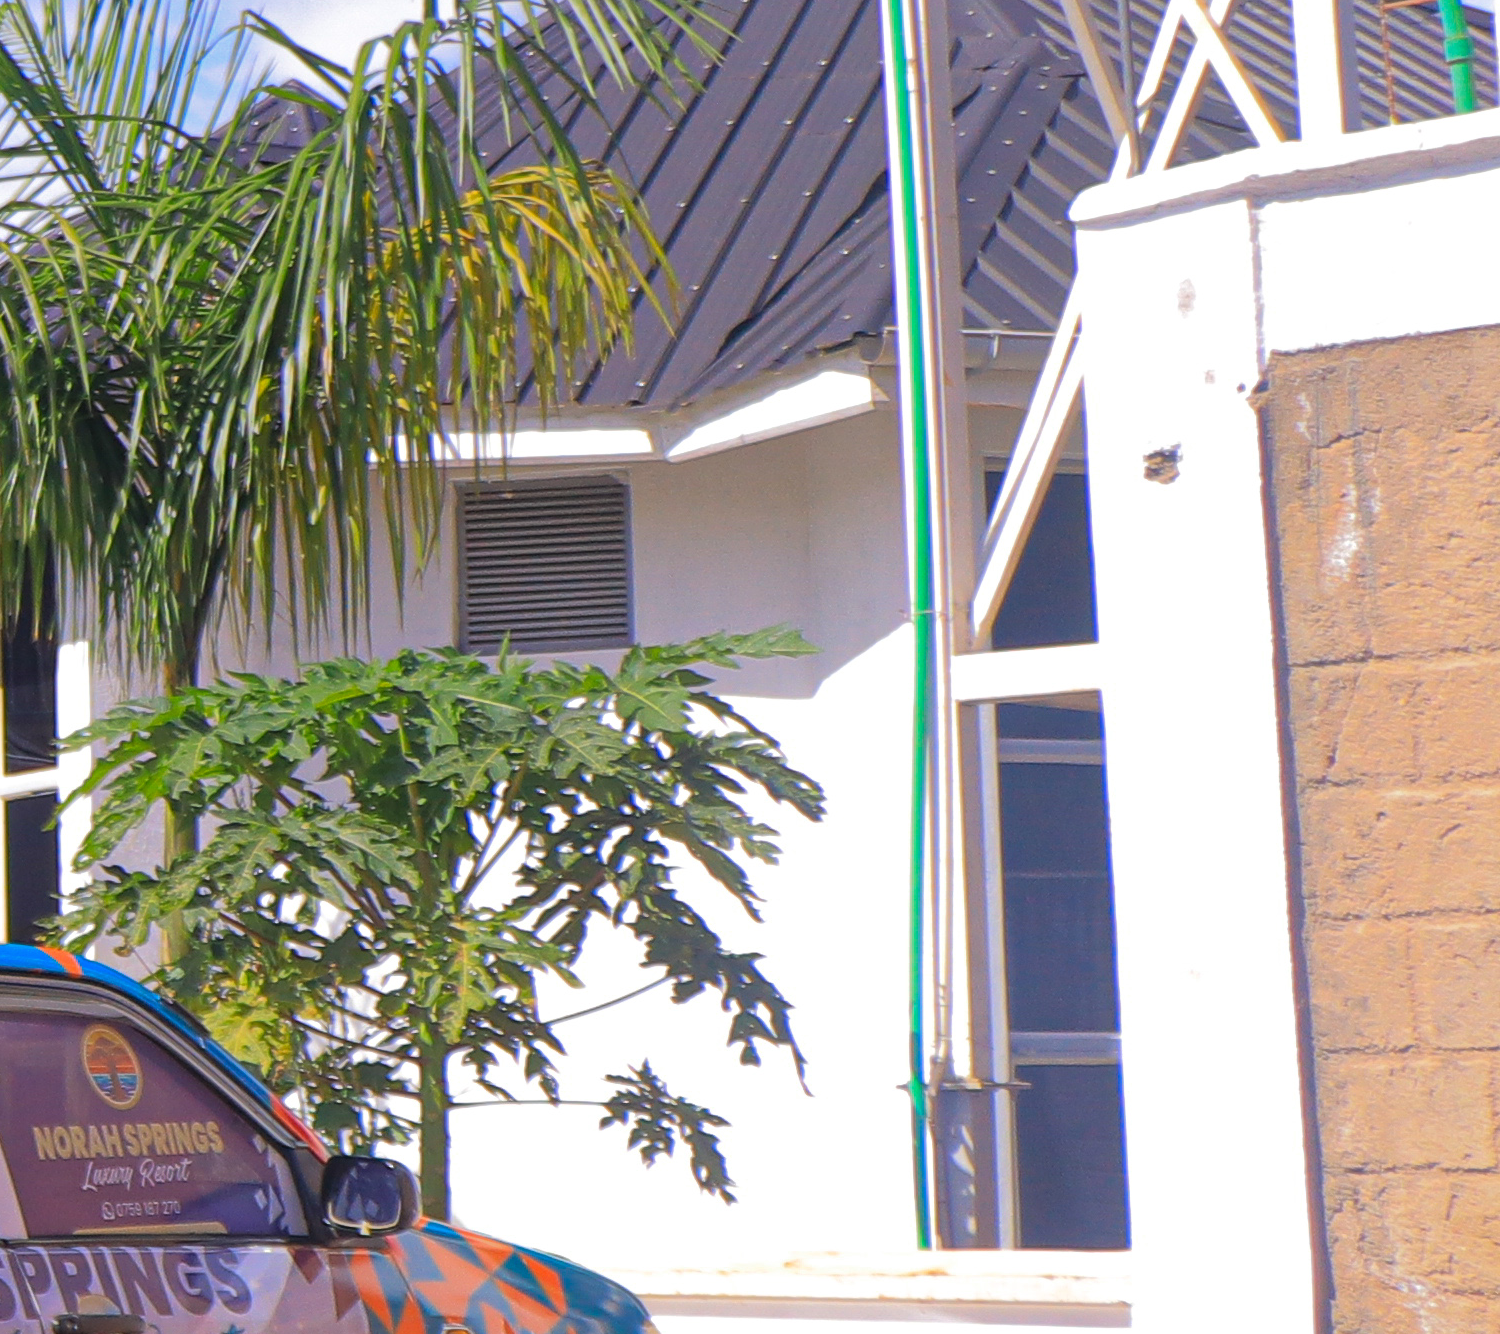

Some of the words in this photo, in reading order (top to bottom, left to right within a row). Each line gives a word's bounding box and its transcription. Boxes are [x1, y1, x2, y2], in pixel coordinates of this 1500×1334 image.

[33, 1124, 124, 1160] NORAH
[123, 1120, 224, 1156] SPRINGS
[81, 1161, 134, 1192] Luxury
[140, 1158, 192, 1187] Resort
[163, 1201, 181, 1216] 270
